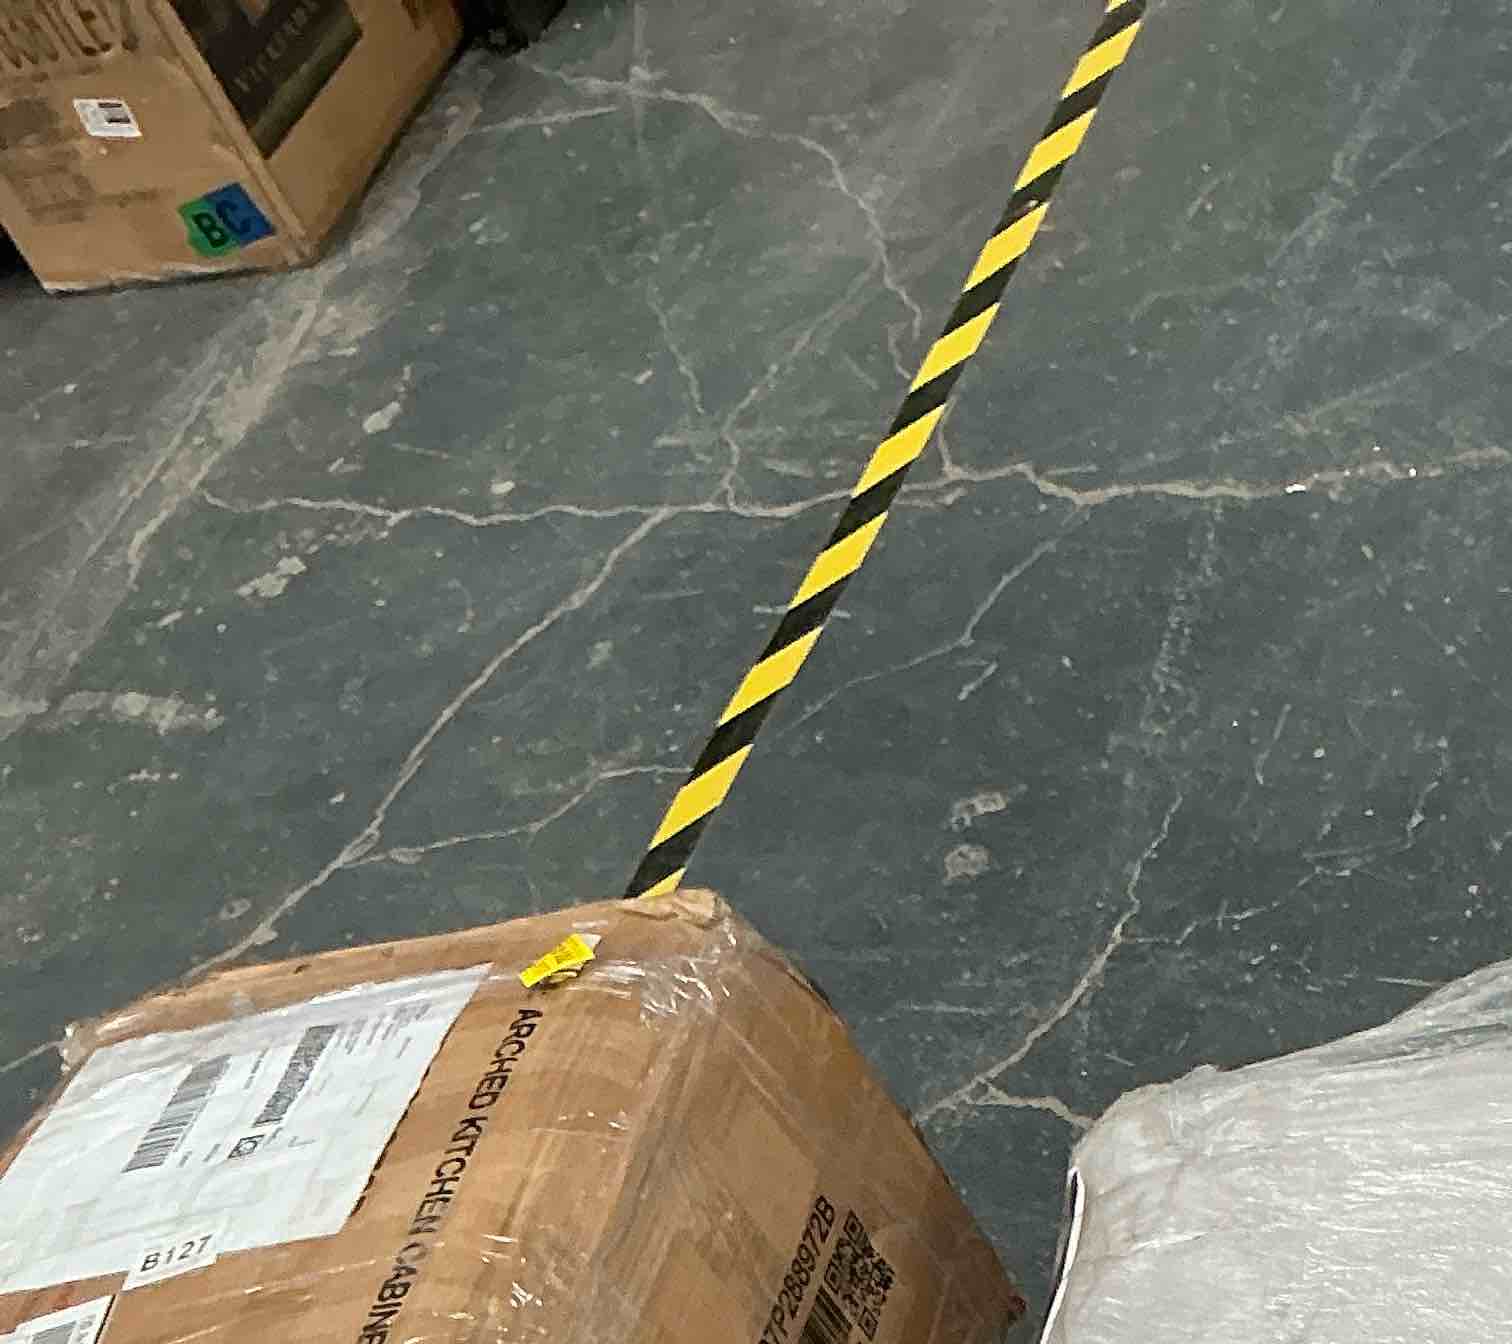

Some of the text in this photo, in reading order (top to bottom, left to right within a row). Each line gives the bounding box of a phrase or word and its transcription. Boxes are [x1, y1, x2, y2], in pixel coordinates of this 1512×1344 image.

[468, 1008, 544, 1110] ARCHED
[408, 1115, 488, 1236] KITCHEN
[140, 1233, 214, 1273] B127
